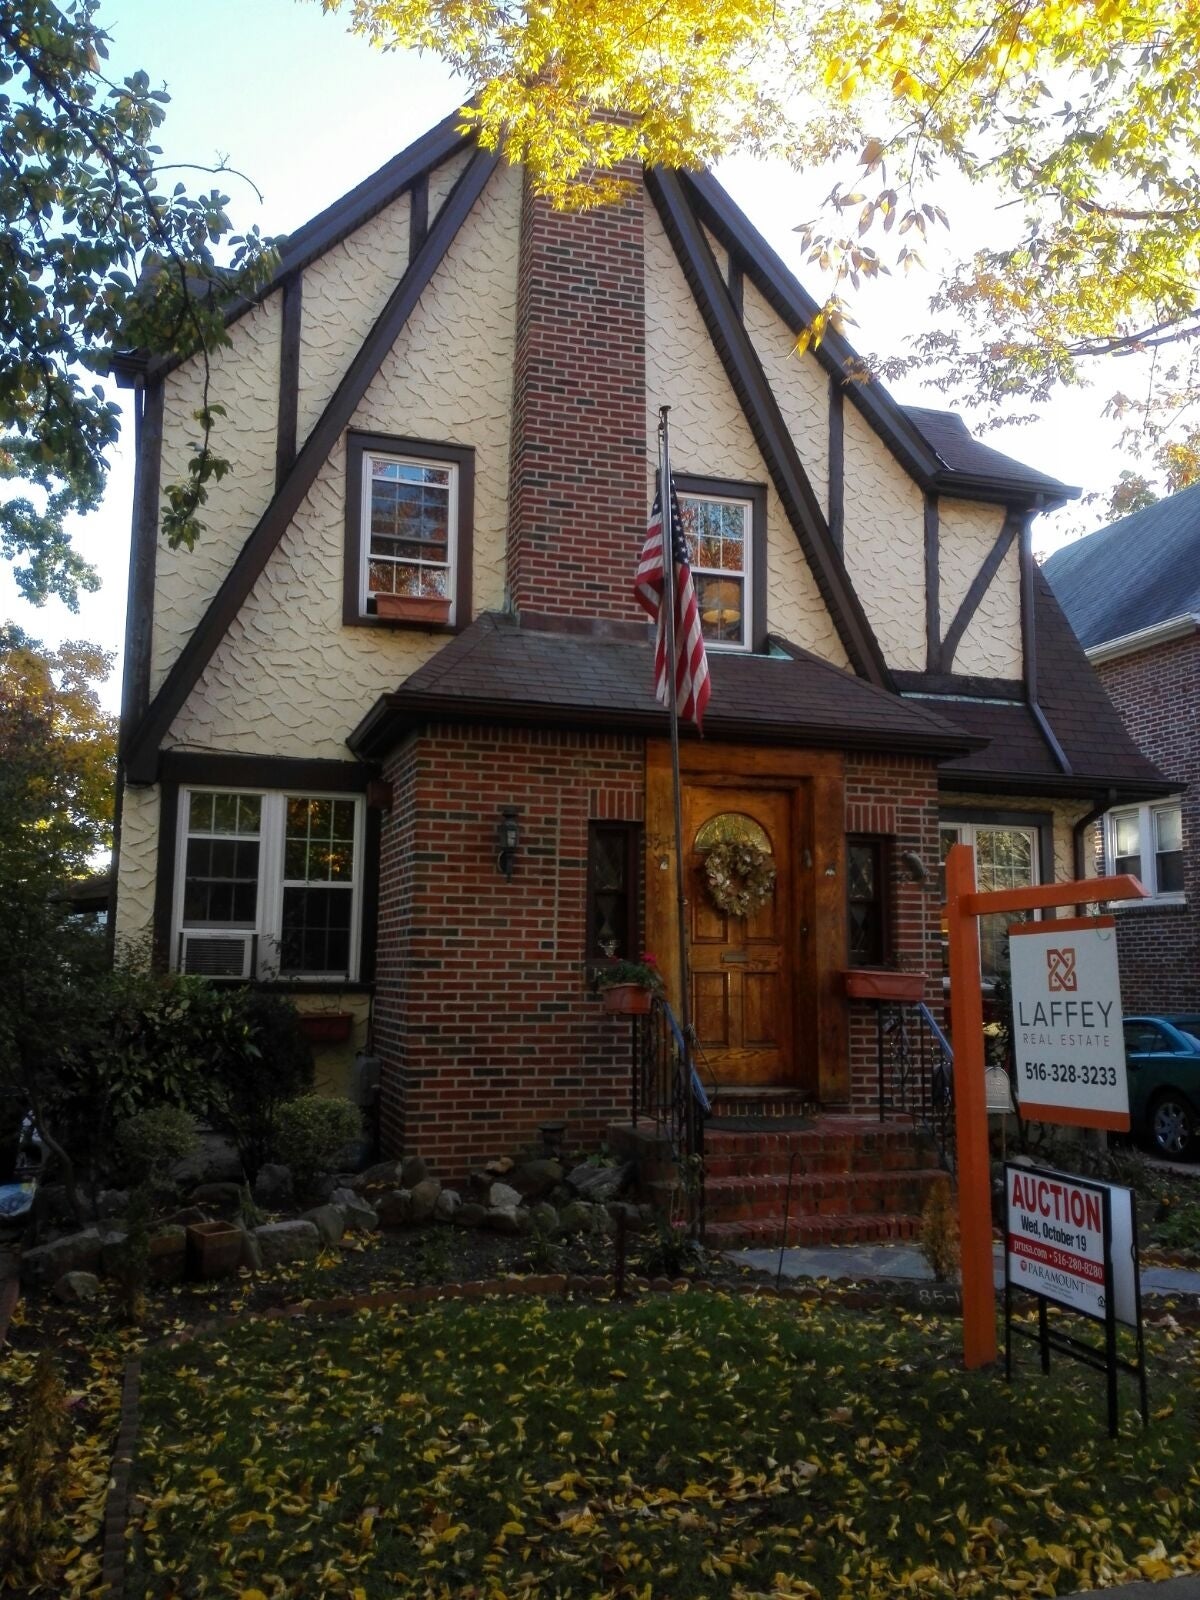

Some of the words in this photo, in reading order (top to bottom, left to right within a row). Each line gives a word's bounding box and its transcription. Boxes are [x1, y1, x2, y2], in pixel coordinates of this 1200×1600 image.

[1018, 1001, 1113, 1028] LAFFEY
[1023, 1033, 1053, 1045] REAL
[1060, 1034, 1110, 1047] ESTATE
[1025, 1062, 1117, 1086] 516-328-3233
[1012, 1174, 1101, 1233] AUCTION
[1021, 1215, 1041, 1238] Wed,
[1043, 1222, 1074, 1247] October
[1076, 1234, 1087, 1252] 19
[1014, 1240, 1048, 1259] prusa.com
[1053, 1251, 1103, 1279] 516-280-8280
[1028, 1262, 1086, 1293] PARAMOUNT
